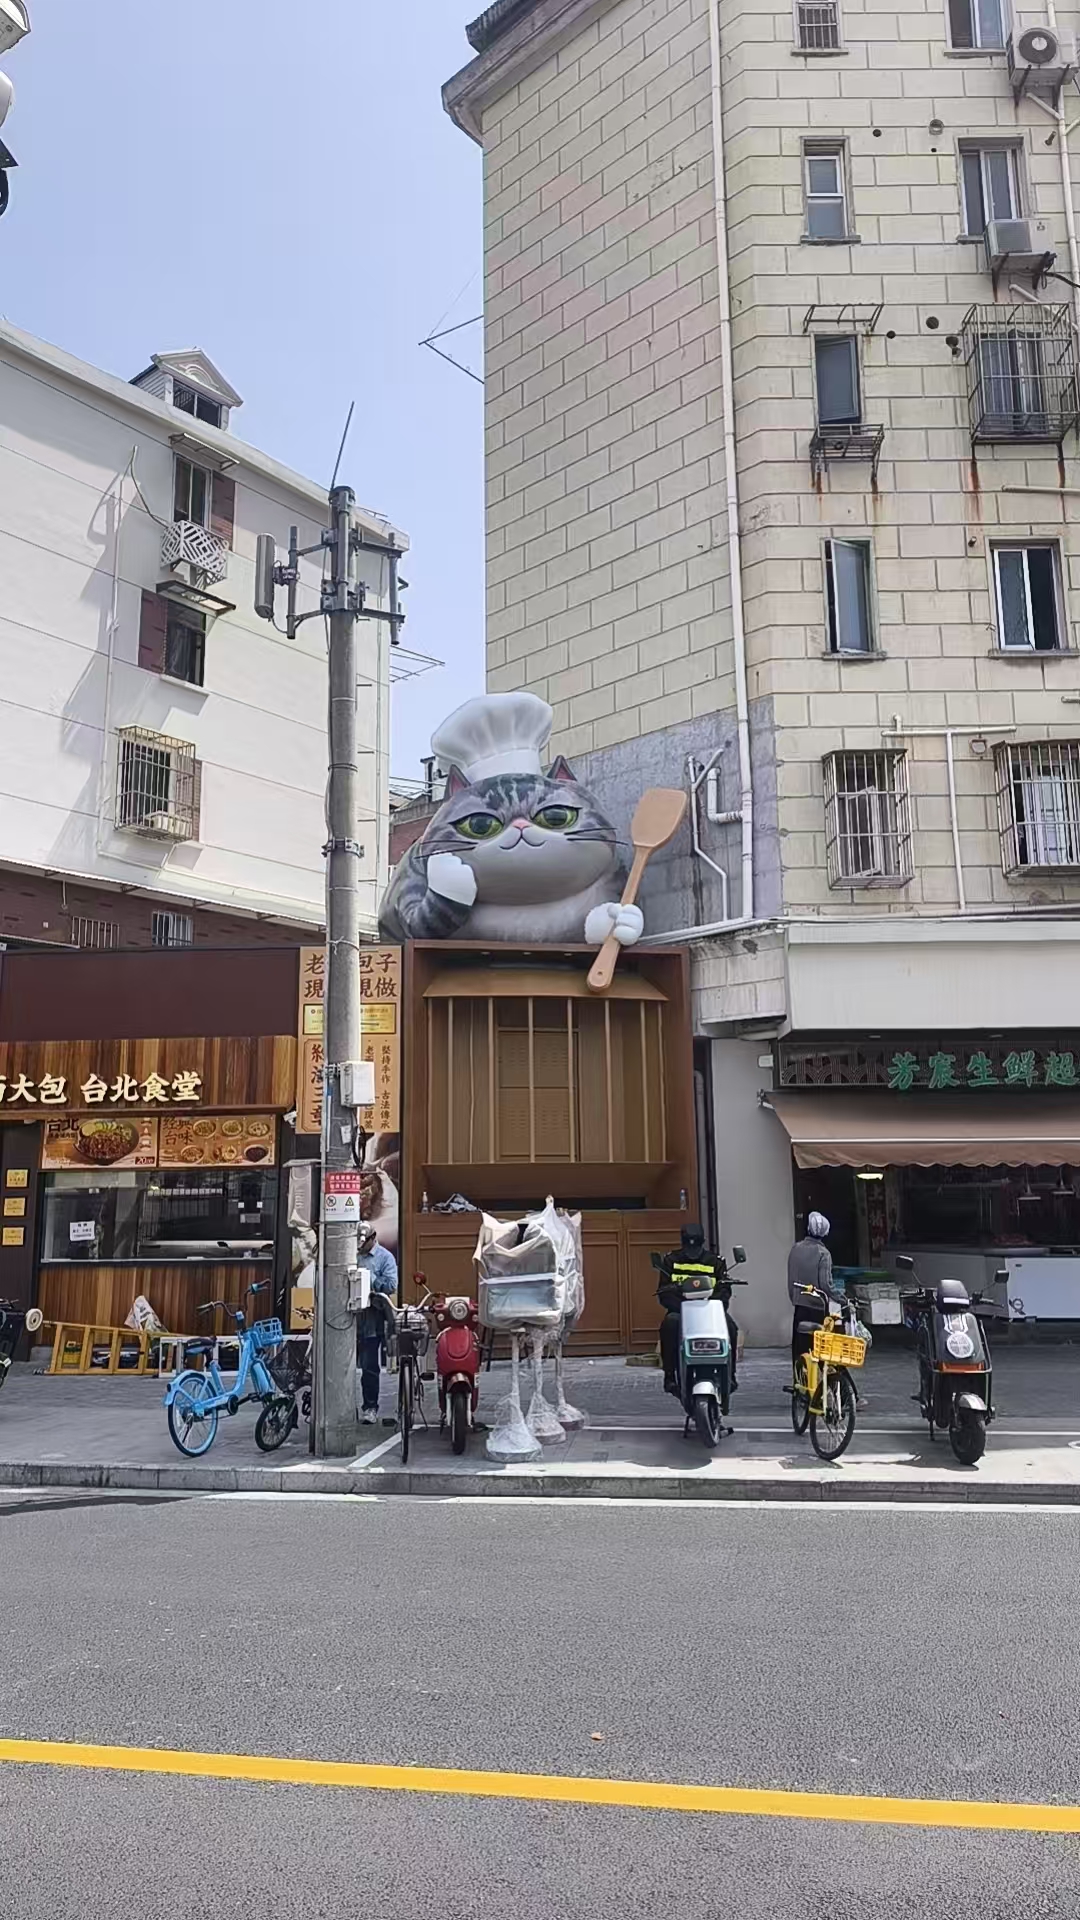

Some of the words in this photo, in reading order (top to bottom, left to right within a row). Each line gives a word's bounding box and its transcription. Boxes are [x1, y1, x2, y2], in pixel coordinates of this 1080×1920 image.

[304, 952, 397, 974] 老包子
[304, 977, 397, 999] 現現做
[0, 1072, 67, 1104] 大包
[80, 1071, 202, 1104] 台北食堂
[165, 1127, 193, 1145] 台味
